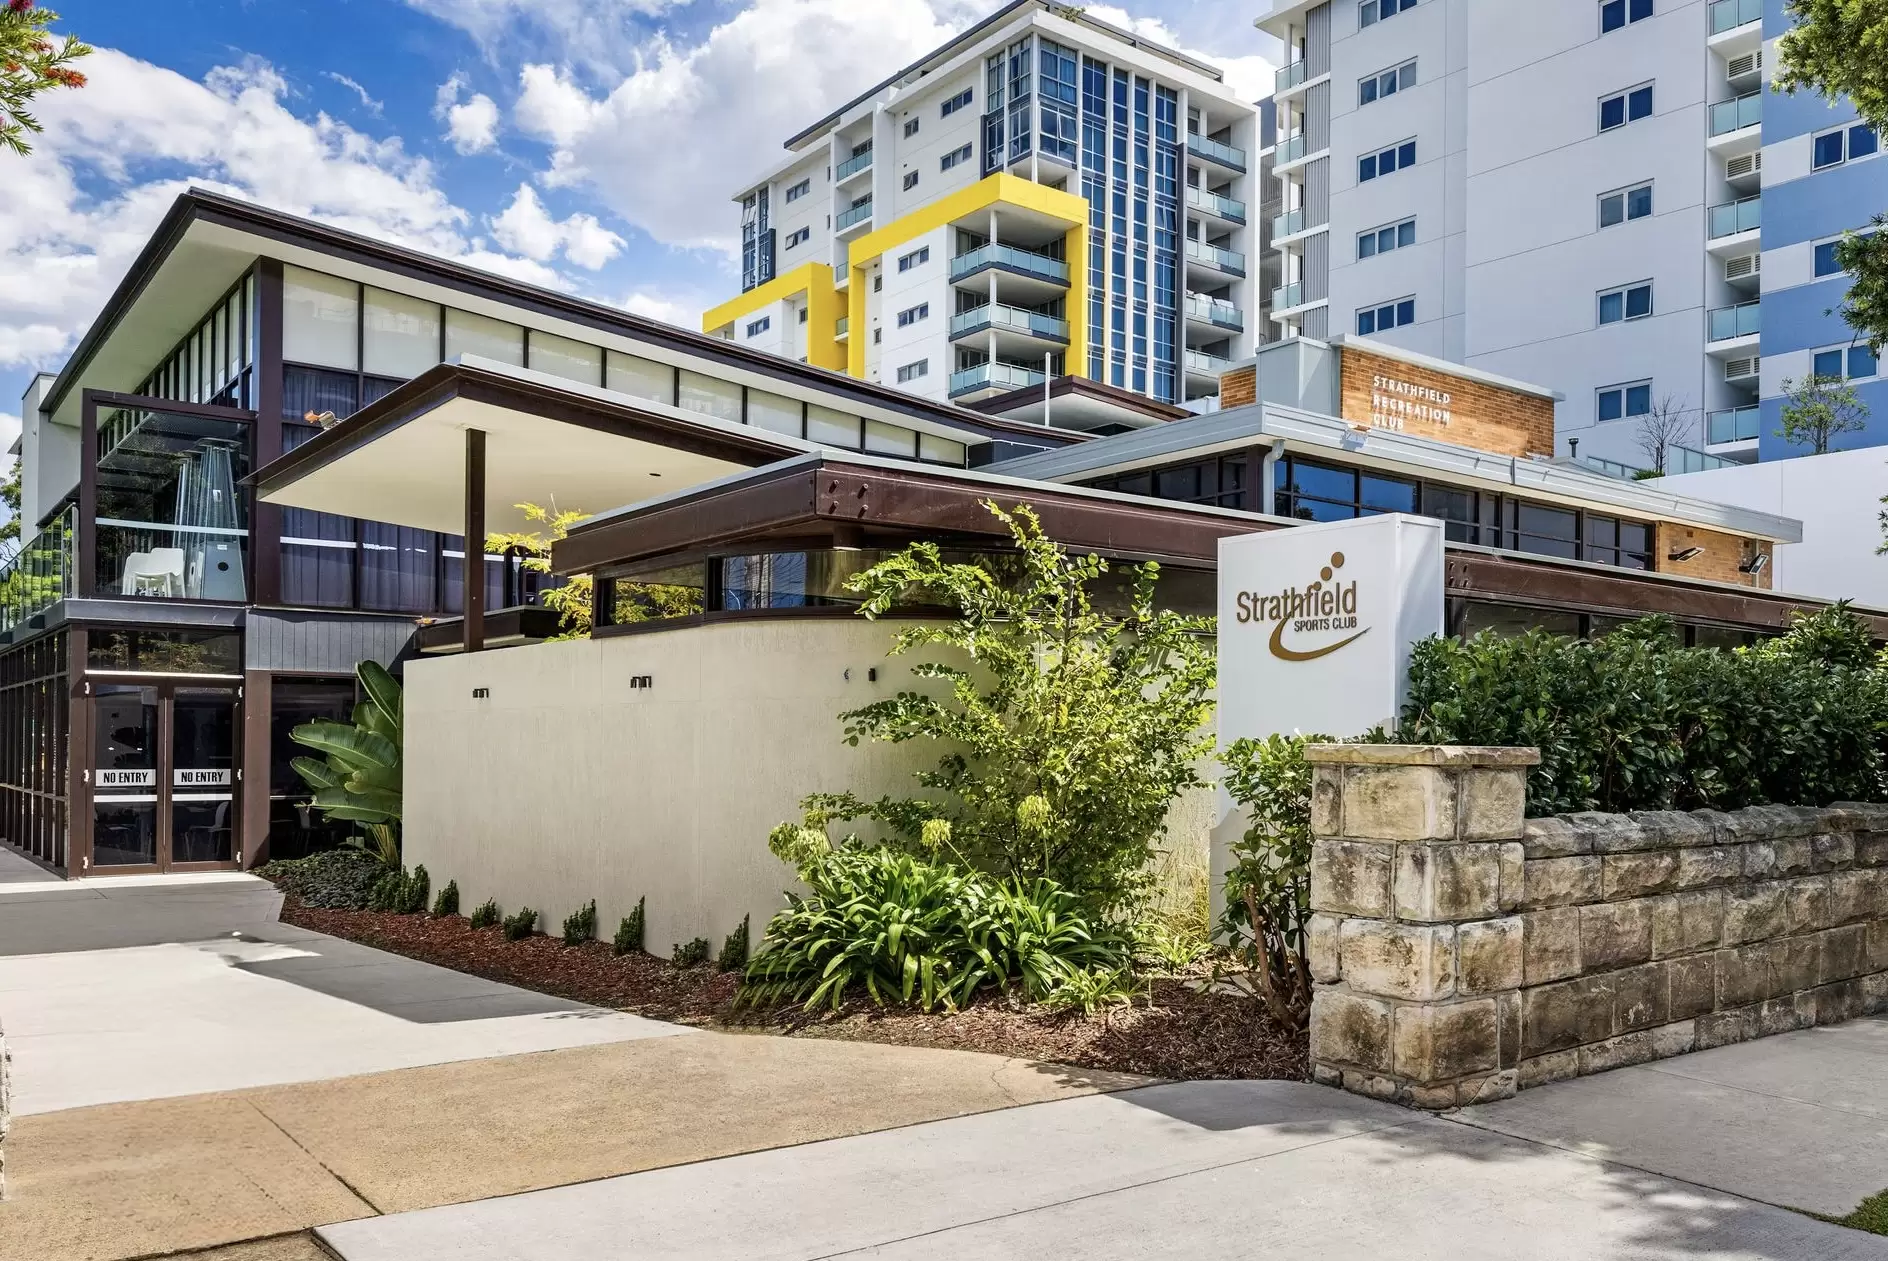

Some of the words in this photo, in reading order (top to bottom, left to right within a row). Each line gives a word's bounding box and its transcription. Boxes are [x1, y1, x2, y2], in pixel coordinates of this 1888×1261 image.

[1373, 375, 1450, 404] STRATHFIELD
[1373, 394, 1450, 422] RECREATION
[1373, 413, 1404, 430] CLUB
[1236, 580, 1357, 623] Strathfield
[1294, 618, 1330, 632] SPORTS
[1332, 616, 1357, 629] CLUB
[103, 772, 116, 783] NO
[118, 772, 149, 783] ENTRY
[181, 771, 194, 782] NO
[195, 771, 224, 782] ENTRY
